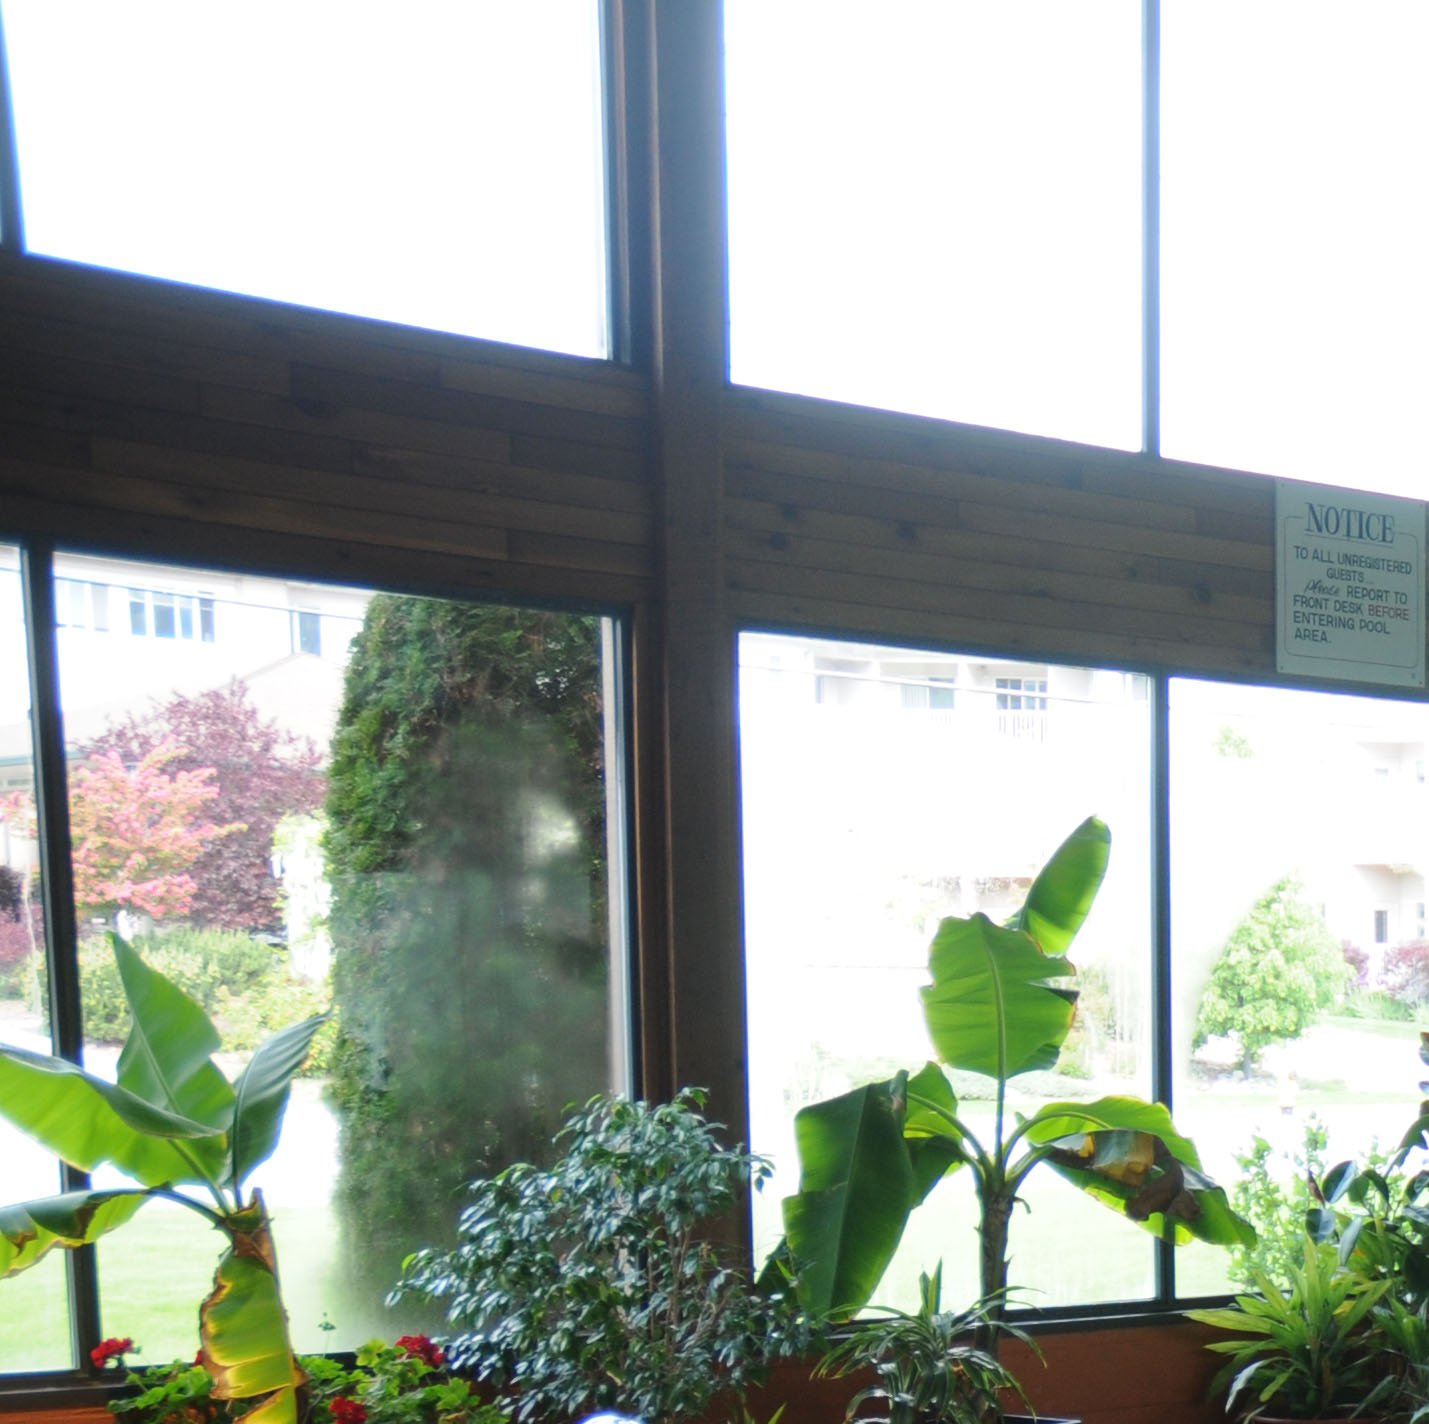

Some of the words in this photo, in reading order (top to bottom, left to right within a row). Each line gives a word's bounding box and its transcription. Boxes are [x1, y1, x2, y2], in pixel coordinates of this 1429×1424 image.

[1304, 502, 1396, 544] NOTICE
[1293, 545, 1309, 560] TO
[1312, 548, 1335, 564] ALL
[1337, 552, 1412, 575] UNREGISTERED
[1293, 594, 1330, 611] FRONT
[1334, 600, 1363, 616] DESK
[1368, 604, 1410, 621] BEFORE
[1346, 585, 1390, 603] REPORT
[1393, 591, 1408, 605] TO
[1293, 611, 1355, 630] ENTERING
[1359, 619, 1391, 635] POOL
